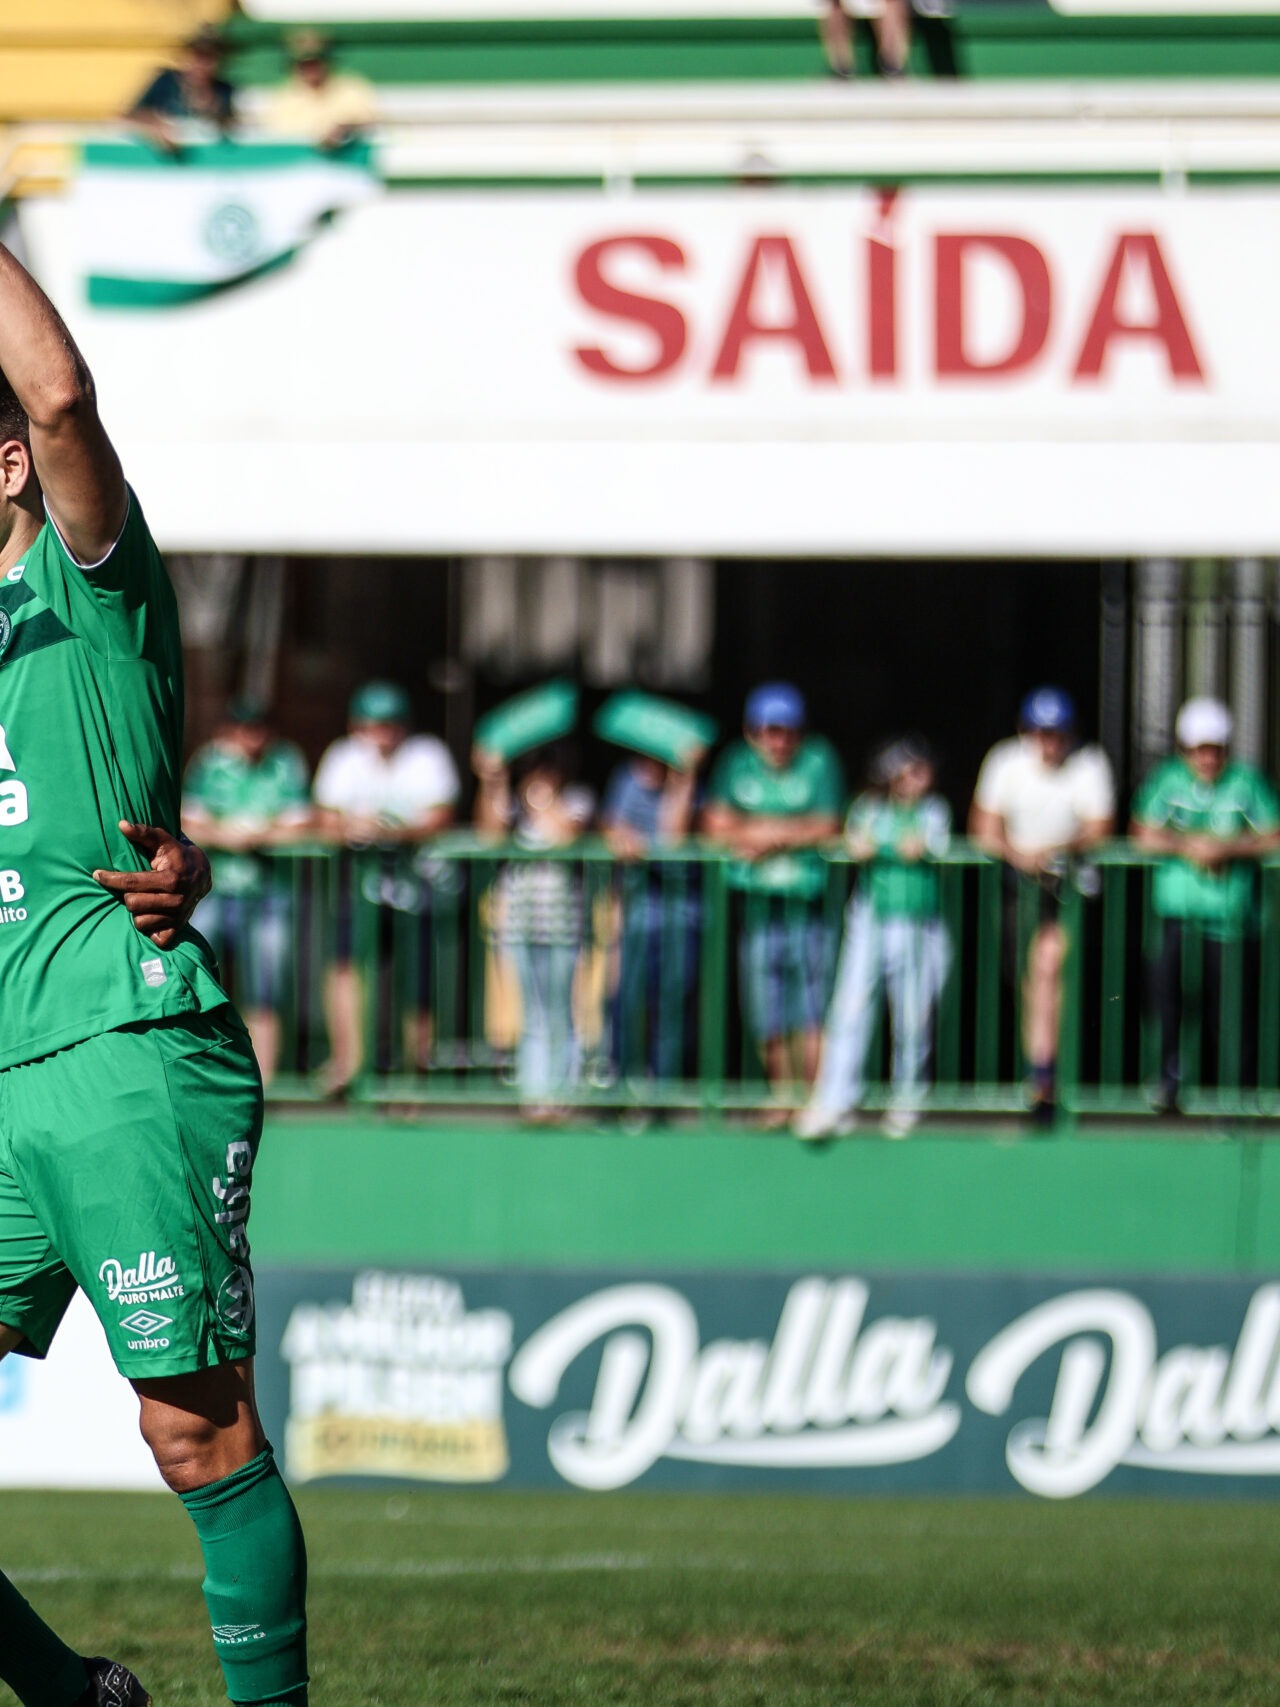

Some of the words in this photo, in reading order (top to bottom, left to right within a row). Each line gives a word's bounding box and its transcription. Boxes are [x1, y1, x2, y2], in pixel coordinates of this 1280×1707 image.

[572, 187, 1208, 382] SAÍDA
[99, 1251, 179, 1300] Dalla
[118, 1292, 148, 1306] PURO
[149, 1285, 185, 1302] MALTE
[127, 1337, 170, 1351] umbro
[509, 1276, 961, 1490] Dalla
[966, 1281, 1280, 1498] Dal
